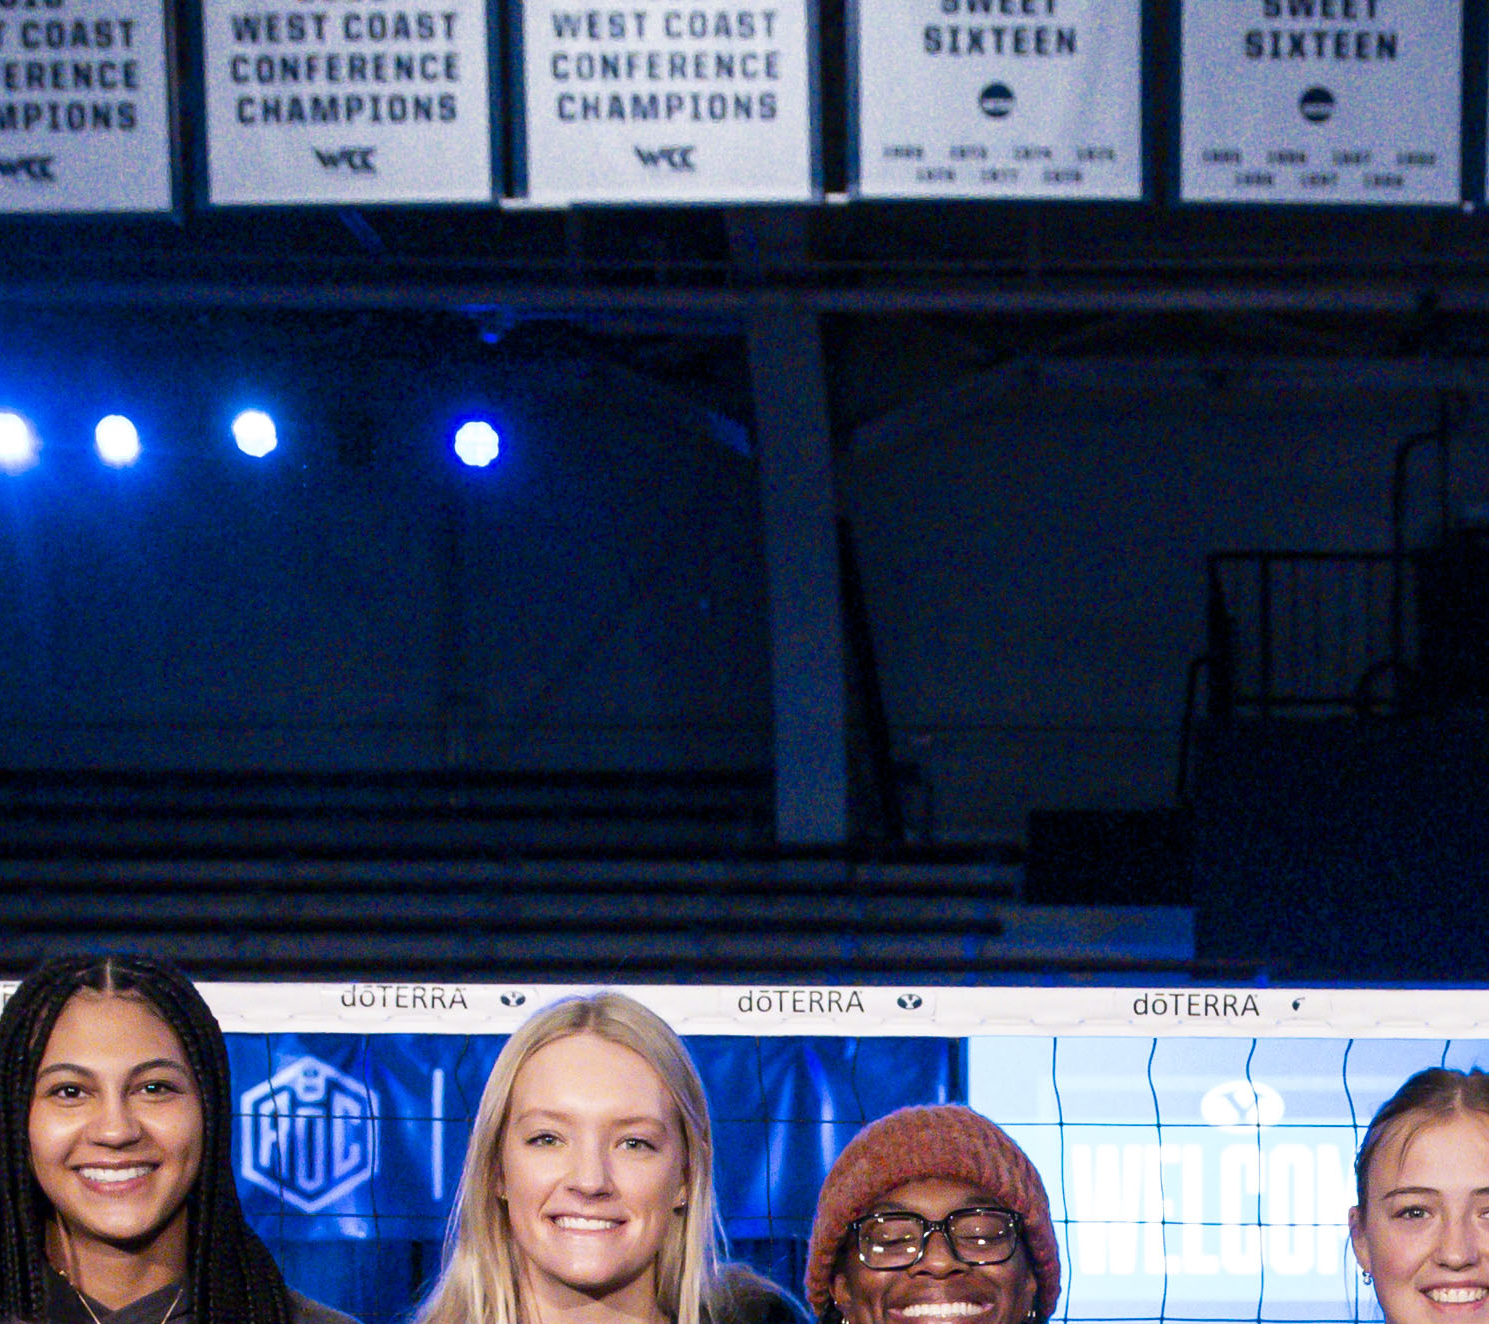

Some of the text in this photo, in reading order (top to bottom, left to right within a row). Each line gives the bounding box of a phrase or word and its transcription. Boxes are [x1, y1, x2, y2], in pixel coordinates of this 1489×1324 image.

[552, 10, 776, 40] WEST COAST
[1263, 0, 1377, 20] SWEET
[21, 20, 133, 50] COAST
[232, 12, 456, 43] WEST COAST
[924, 26, 1076, 56] SIXTEEN
[1245, 30, 1397, 60] SIXTEEN
[229, 54, 455, 85] CONFERENCE
[551, 51, 778, 81] CONFERENCE
[236, 95, 456, 126] CHAMPIONS
[557, 93, 777, 121] CHAMPIONS
[1071, 1143, 1354, 1276] WELCOM
